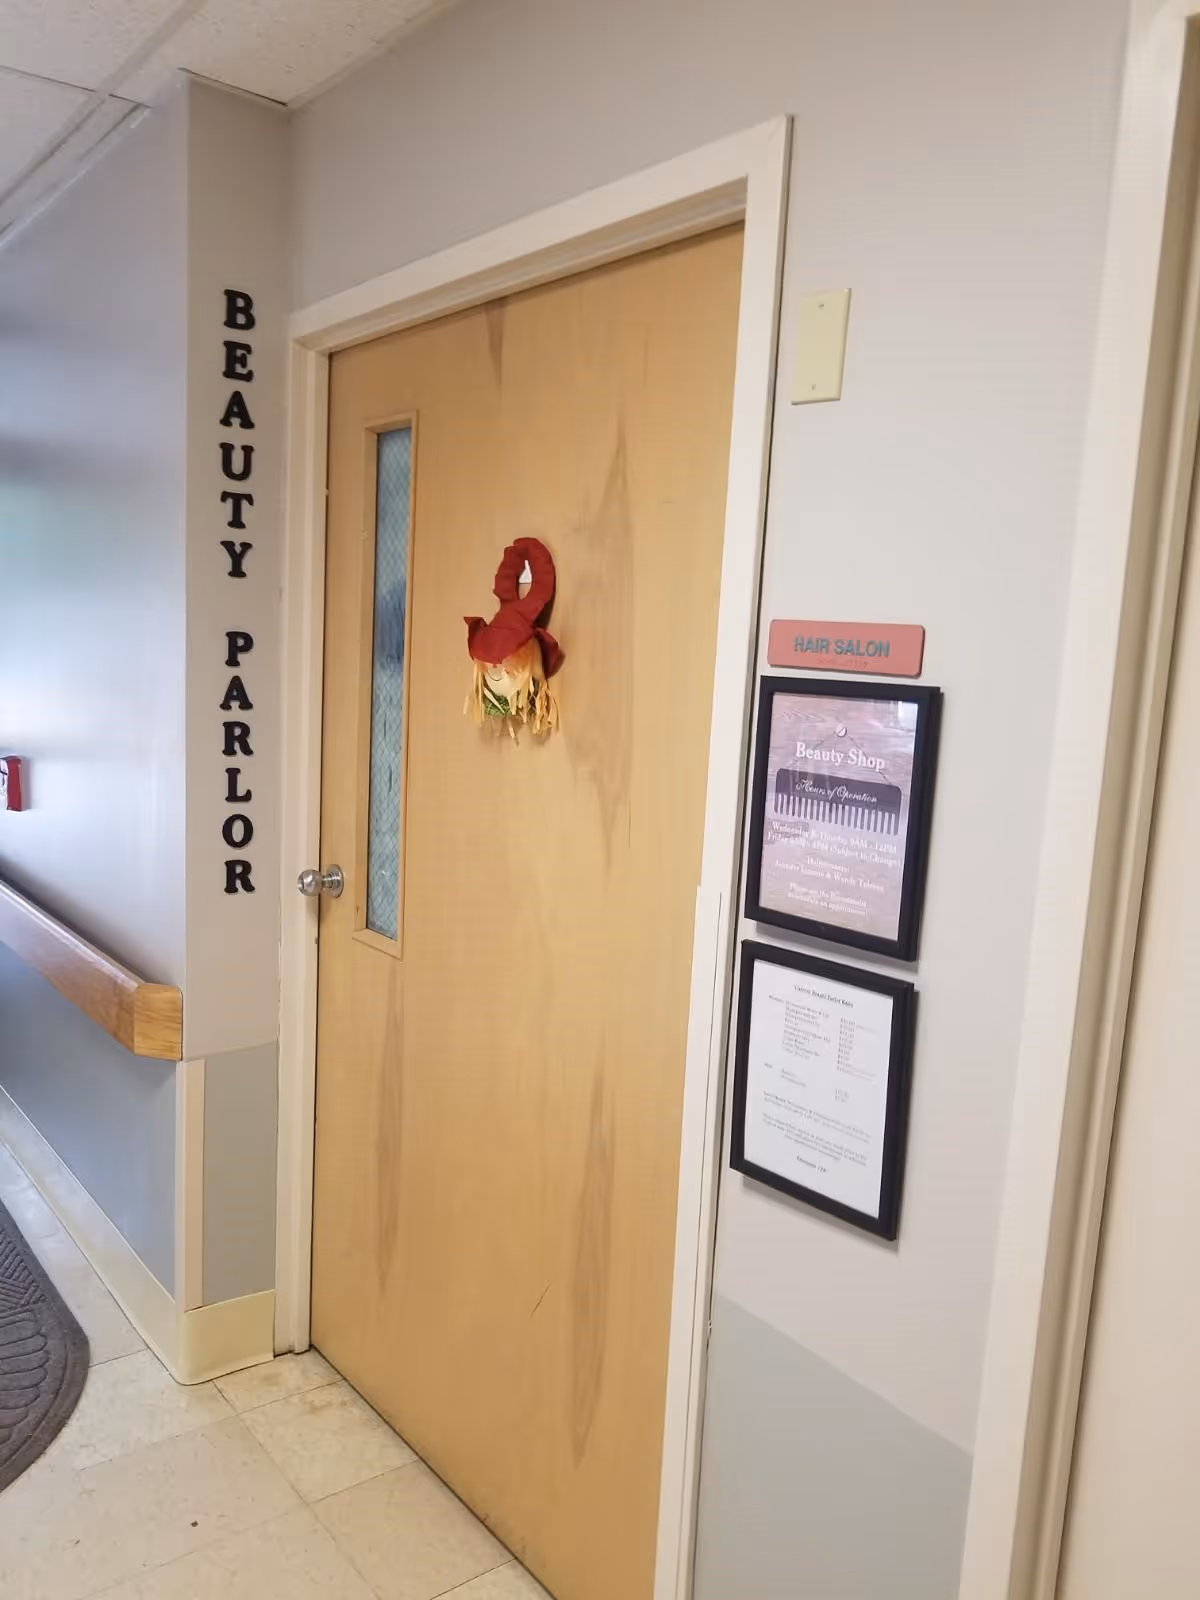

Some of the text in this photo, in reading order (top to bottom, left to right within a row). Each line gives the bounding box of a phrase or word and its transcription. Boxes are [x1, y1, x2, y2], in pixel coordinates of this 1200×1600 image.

[219, 289, 255, 895] BEAUTY PARLOR
[793, 635, 890, 658] HAIR SALON
[795, 741, 886, 772] Beauty Shop
[795, 779, 878, 802] Hours of Operation
